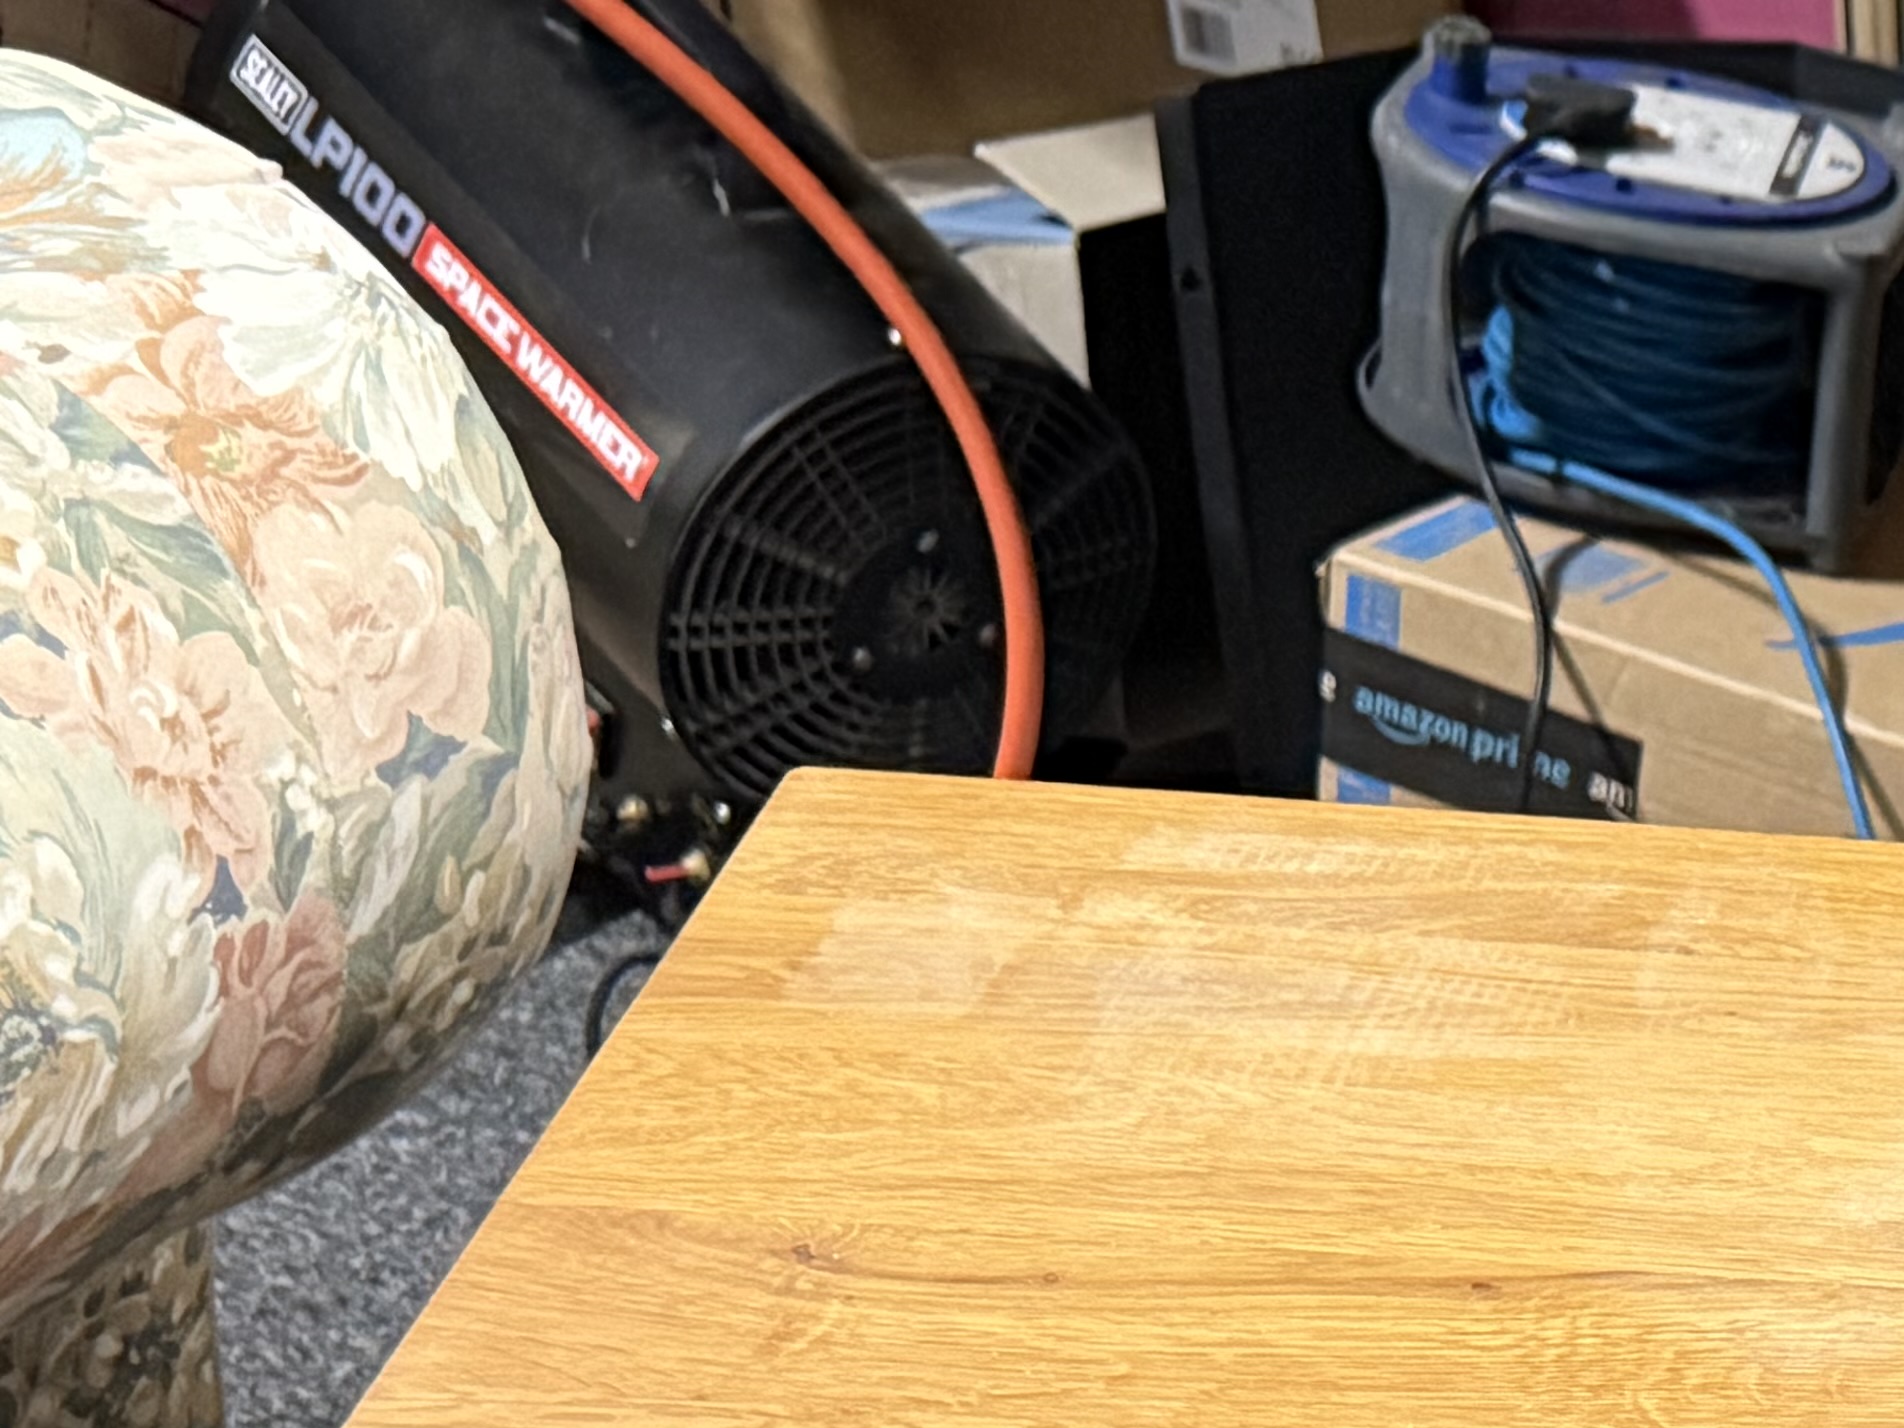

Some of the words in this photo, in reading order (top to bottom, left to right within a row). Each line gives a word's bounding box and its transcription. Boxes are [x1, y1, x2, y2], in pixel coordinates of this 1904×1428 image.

[289, 96, 427, 258] LP100
[424, 242, 521, 354] SPACE
[515, 331, 644, 482] WARMER
